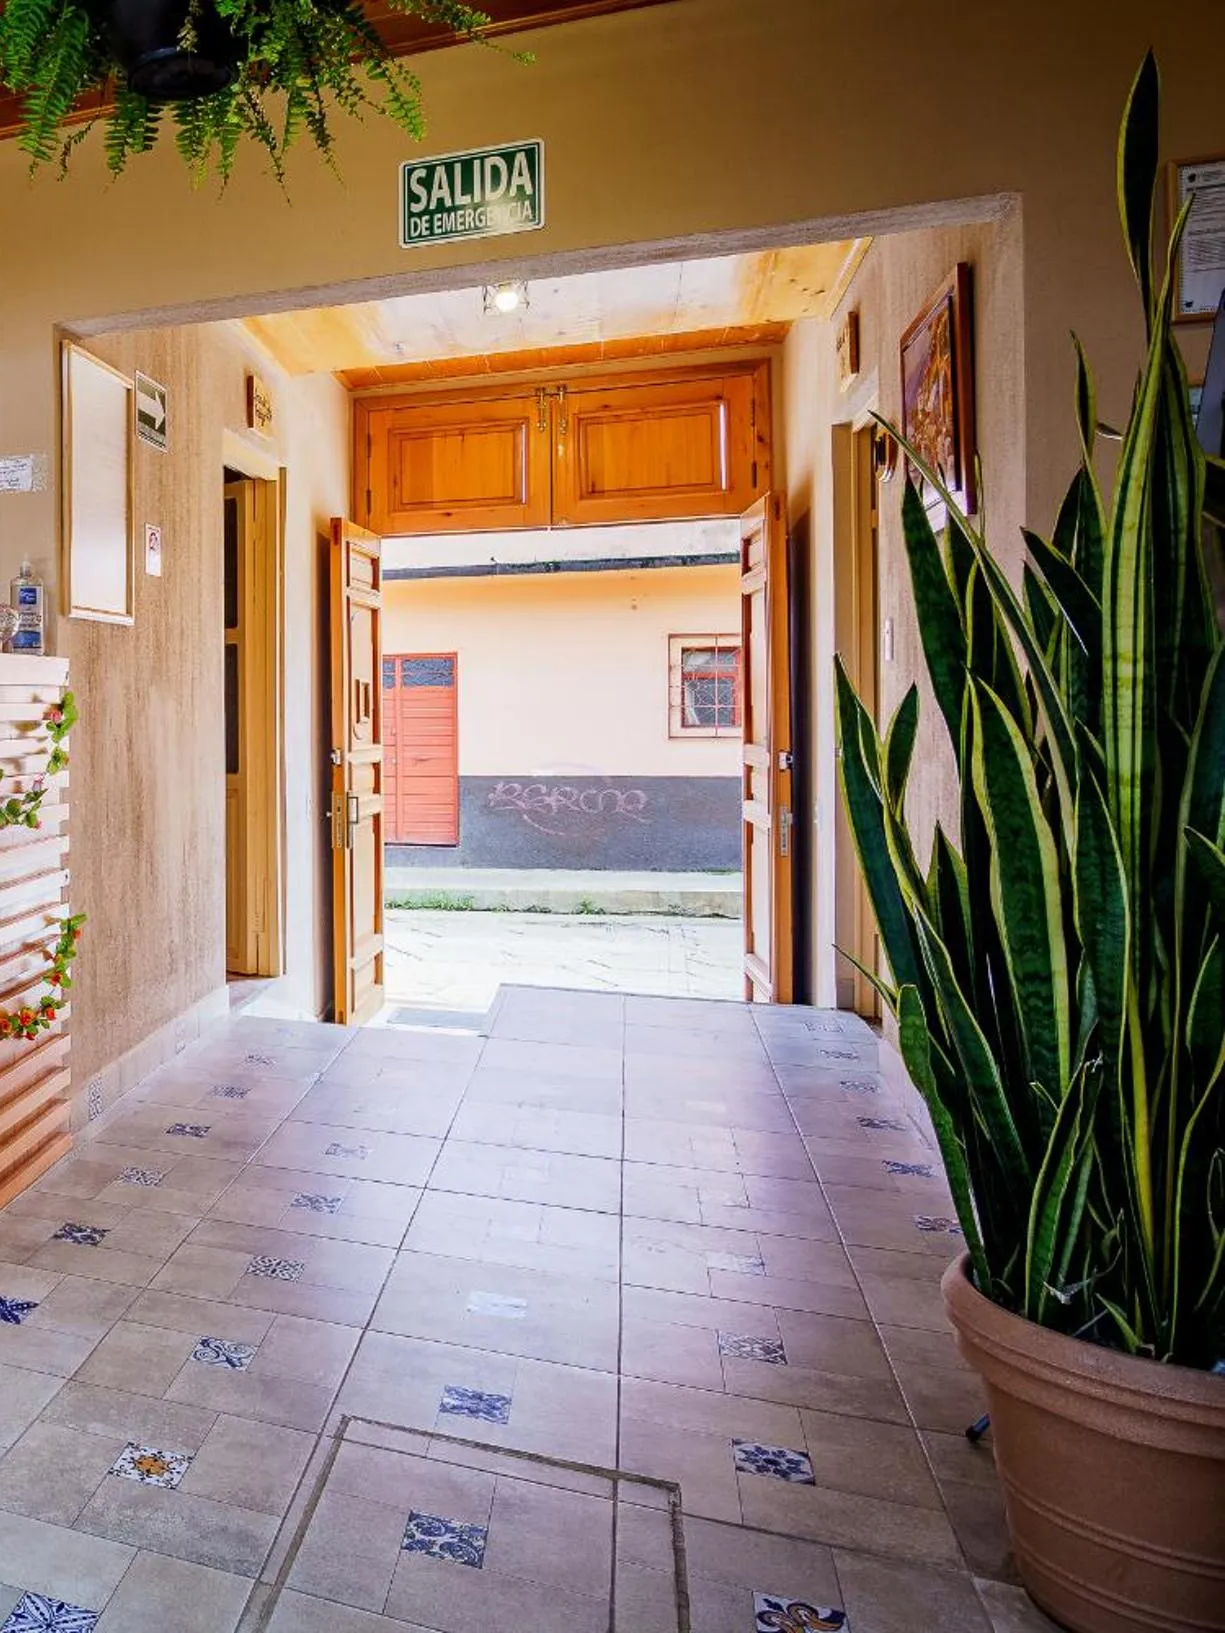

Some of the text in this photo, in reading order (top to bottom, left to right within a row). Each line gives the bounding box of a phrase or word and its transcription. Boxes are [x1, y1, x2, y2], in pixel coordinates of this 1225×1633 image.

[409, 151, 533, 213] SALIDA
[410, 200, 534, 237] DE EMERGECIA
